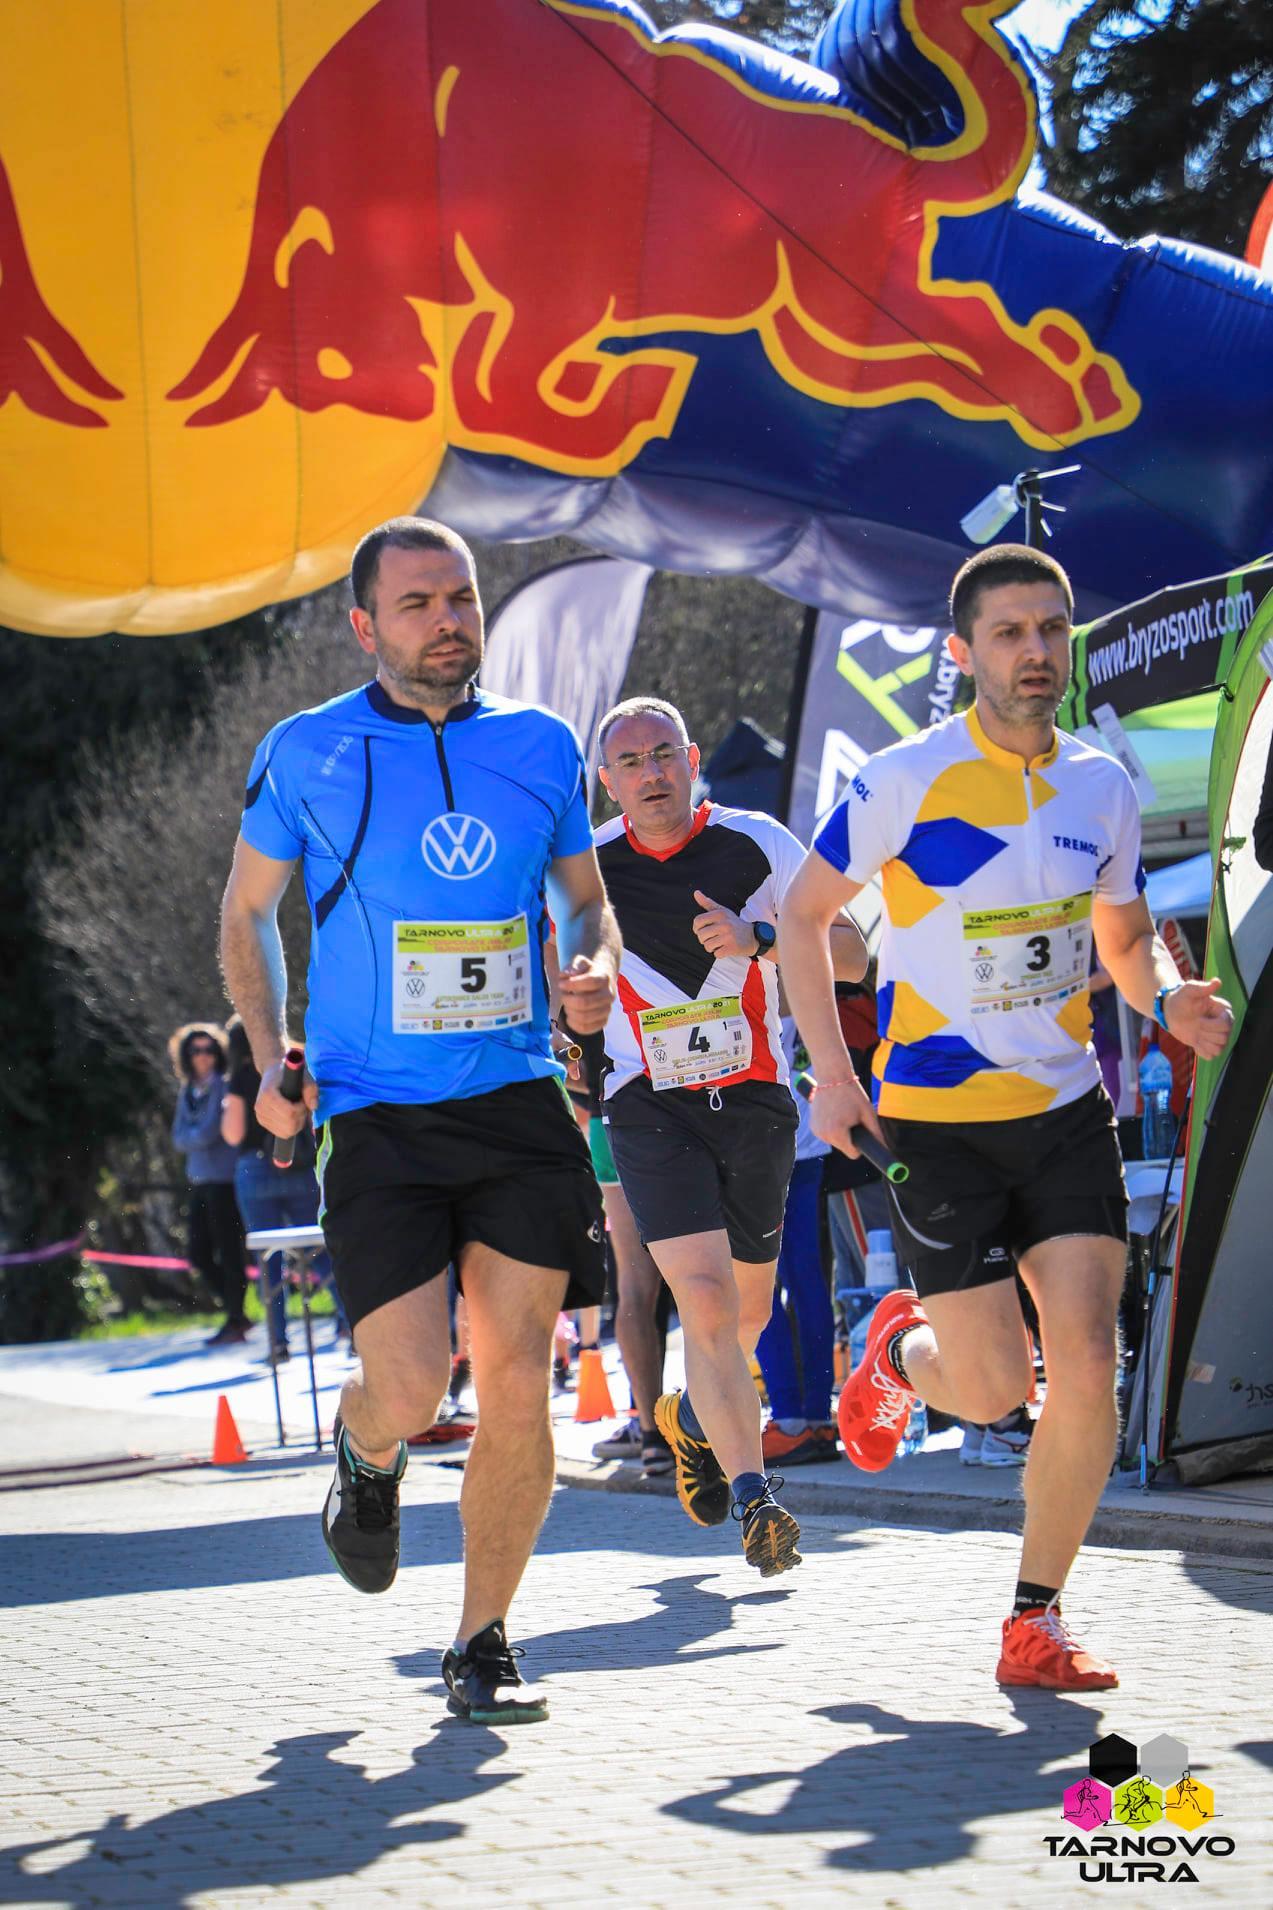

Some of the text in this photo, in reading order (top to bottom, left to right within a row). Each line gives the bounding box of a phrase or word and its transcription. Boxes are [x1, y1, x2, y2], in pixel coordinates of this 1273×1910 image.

[1088, 590, 1254, 687] www.bryzosport.com
[405, 928, 465, 937] TARNOVO
[1026, 935, 1051, 971] 3
[461, 957, 487, 993] 5
[645, 1008, 687, 1021] TARNOVO
[688, 1026, 711, 1053] 4
